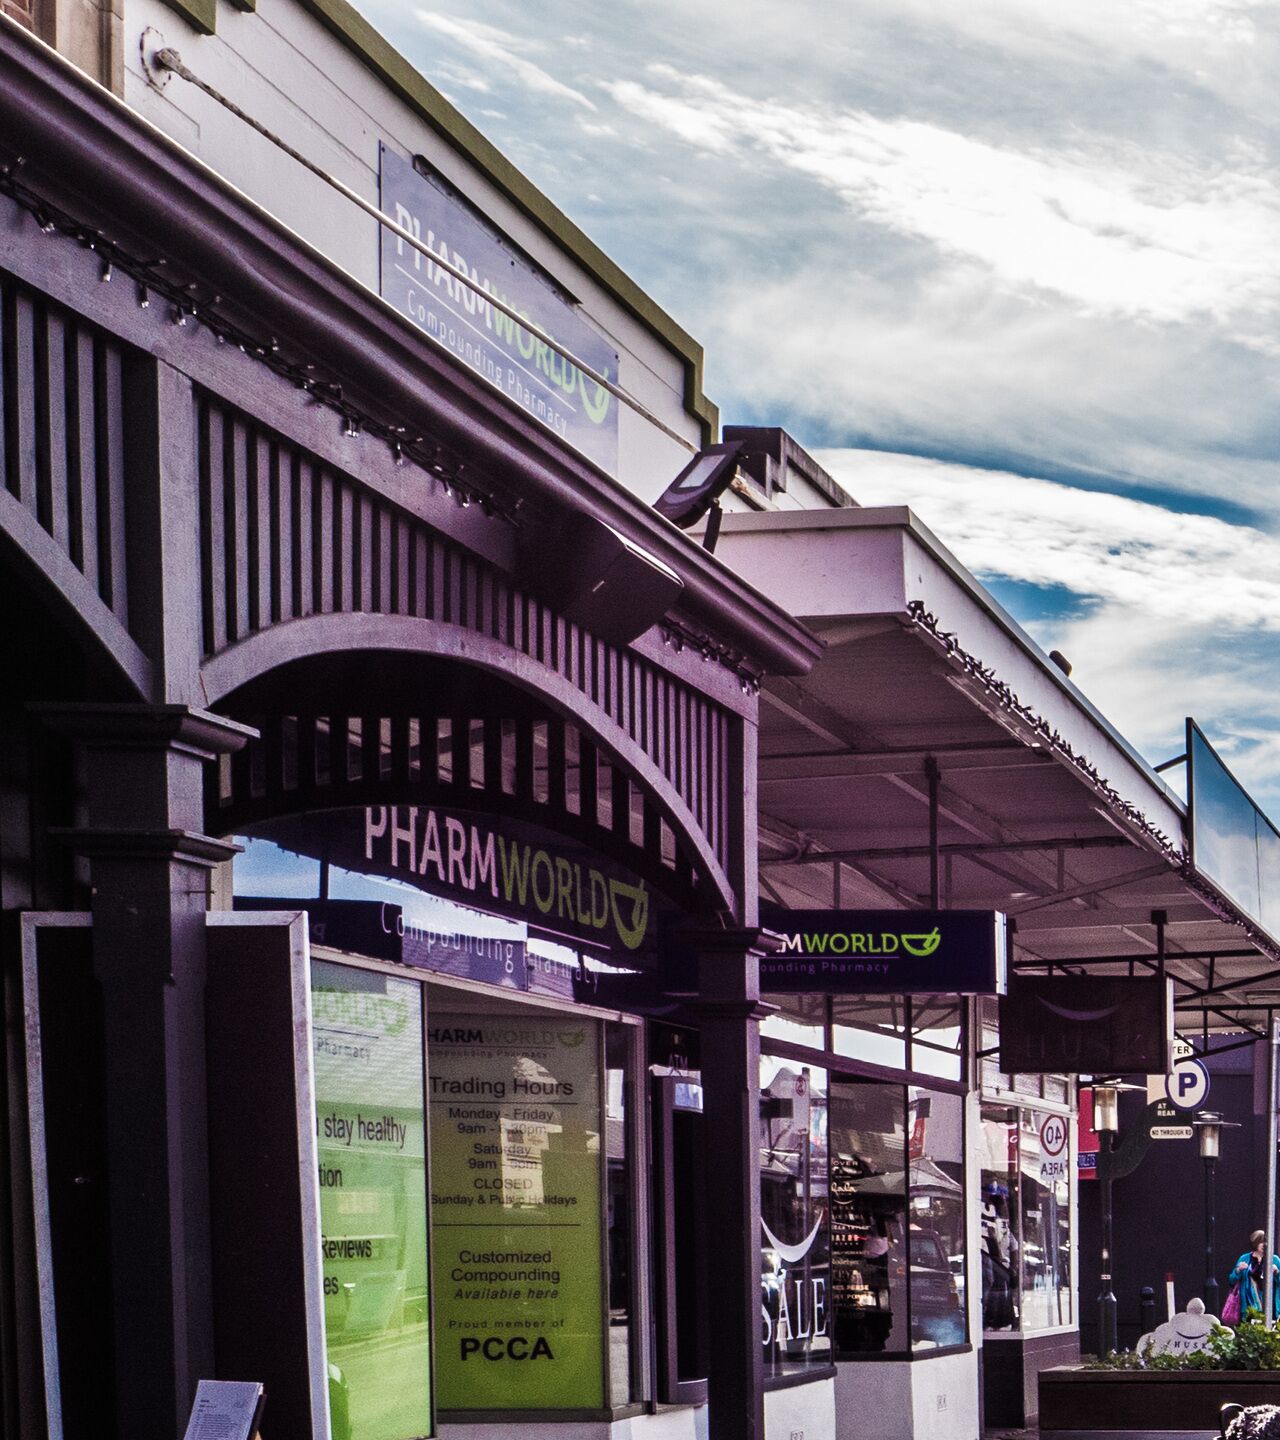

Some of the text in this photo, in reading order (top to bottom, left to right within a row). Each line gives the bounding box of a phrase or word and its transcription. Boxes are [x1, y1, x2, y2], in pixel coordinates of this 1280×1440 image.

[407, 290, 568, 433] Compounding Pharmacy
[365, 806, 609, 929] PHARMWORLD
[381, 902, 515, 974] Compounding
[776, 933, 899, 953] MWORLD
[760, 961, 890, 975] ounding Pharmacy
[428, 1028, 555, 1045] HARMWORLD
[430, 1076, 574, 1098] Trading Hours
[1178, 1072, 1198, 1097] P
[449, 1108, 501, 1121] Monday
[513, 1108, 555, 1121] Friday
[324, 1112, 407, 1149] stay healthy
[457, 1123, 486, 1135] 9am
[473, 1143, 532, 1157] Saturday
[468, 1158, 497, 1170] 9am
[319, 1163, 343, 1187] tion
[473, 1178, 533, 1189] CLOSED
[432, 1195, 474, 1206] Sunday
[478, 1195, 486, 1205] &
[528, 1195, 577, 1206] Holidays
[459, 1250, 552, 1264] Customized
[451, 1268, 561, 1284] Compounding
[455, 1287, 559, 1299] Available here
[761, 1271, 827, 1346] SALE
[449, 1319, 565, 1329] Proud member of
[460, 1336, 555, 1361] PCCA
[1174, 1341, 1208, 1350] HUSK
